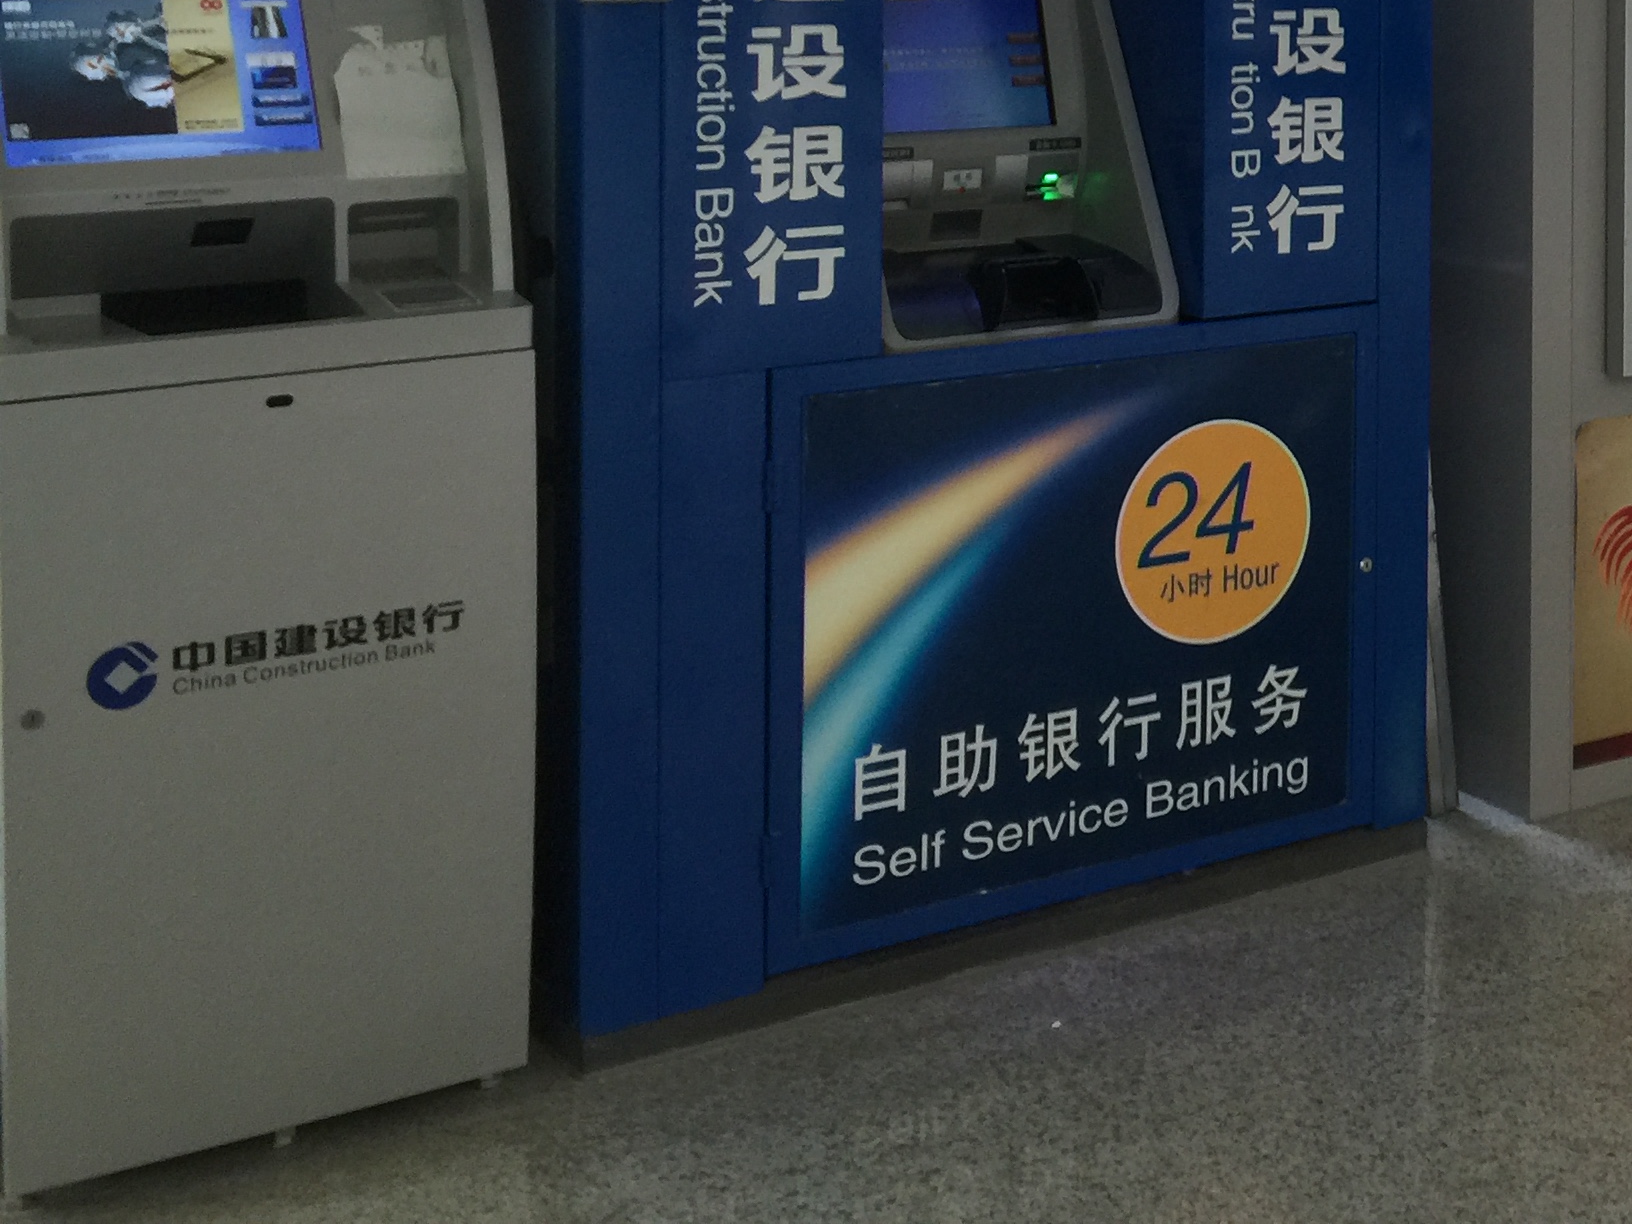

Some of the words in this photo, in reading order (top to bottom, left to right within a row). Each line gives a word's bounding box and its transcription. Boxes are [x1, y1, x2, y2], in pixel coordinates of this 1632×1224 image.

[692, 186, 734, 307] Bank
[1231, 148, 1262, 254] Bnk
[1137, 461, 1255, 569] 24
[1160, 569, 1212, 602] 小时
[1222, 560, 1280, 594] Hour
[172, 599, 465, 672] 中国建设银行
[173, 670, 238, 695] China
[243, 649, 379, 686] Construction
[385, 639, 436, 662] Bank
[853, 664, 1307, 821] 自助银行服务
[853, 830, 946, 887] Self
[961, 799, 1129, 862] Service
[1145, 754, 1309, 818] Banking
